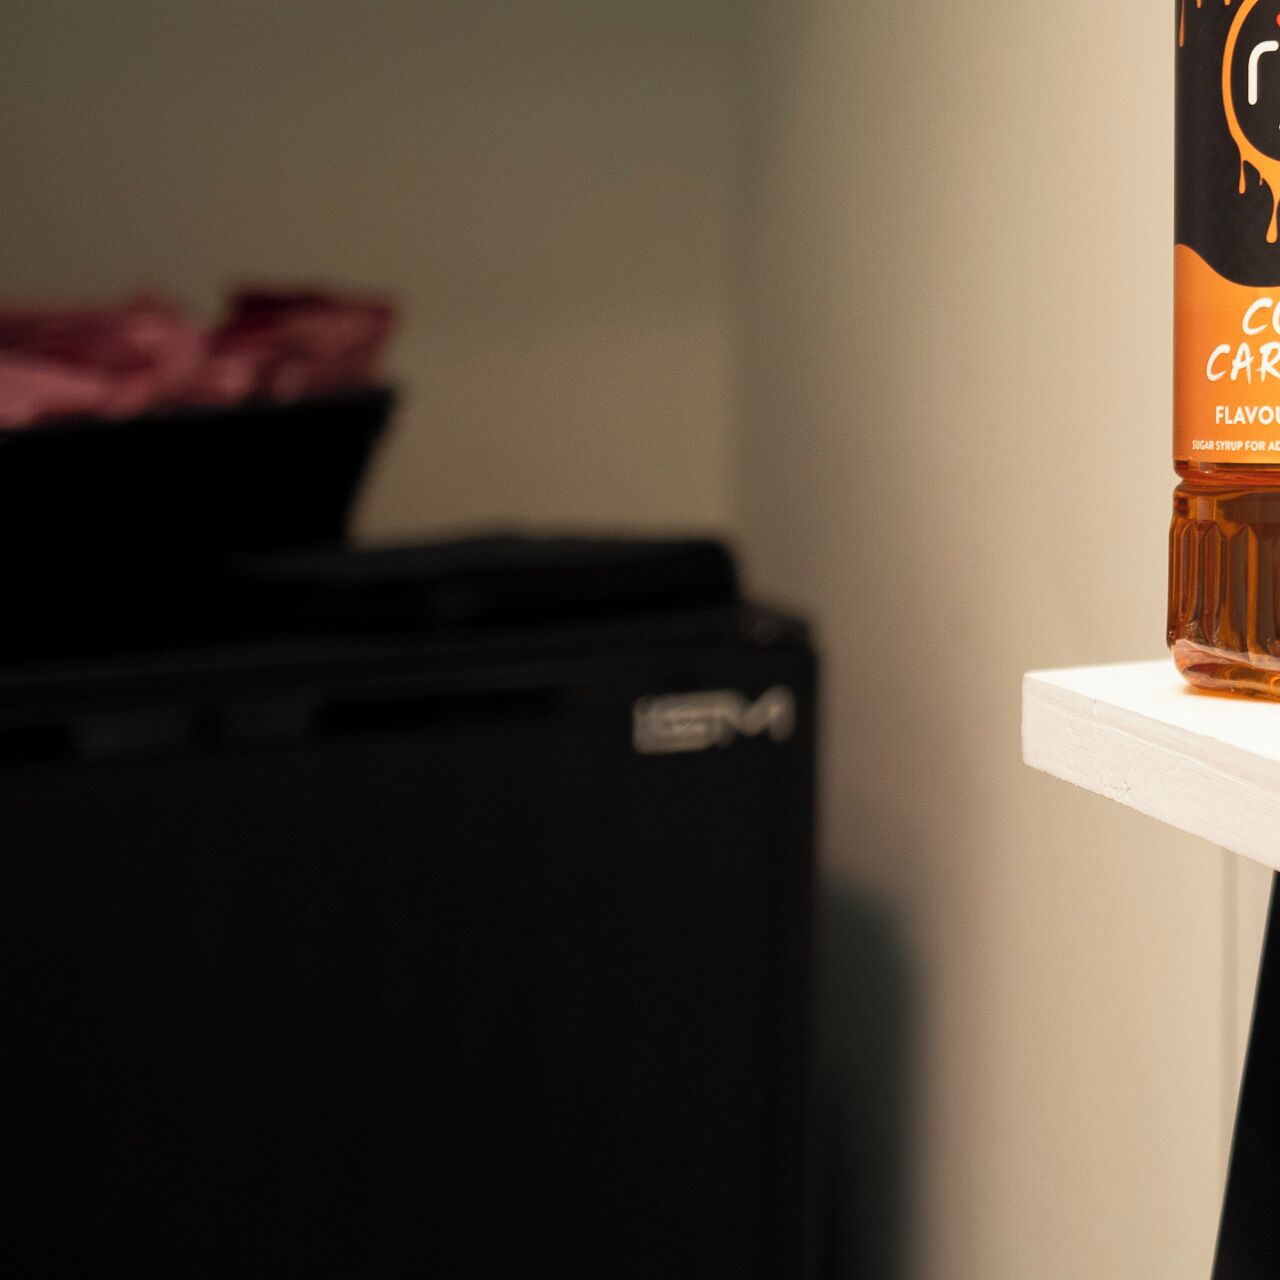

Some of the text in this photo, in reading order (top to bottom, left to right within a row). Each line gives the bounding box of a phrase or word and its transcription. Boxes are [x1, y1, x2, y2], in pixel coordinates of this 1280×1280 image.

[1191, 439, 1214, 451] SUGAR
[1215, 439, 1243, 452] SYRUP
[1244, 440, 1267, 452] FOR
